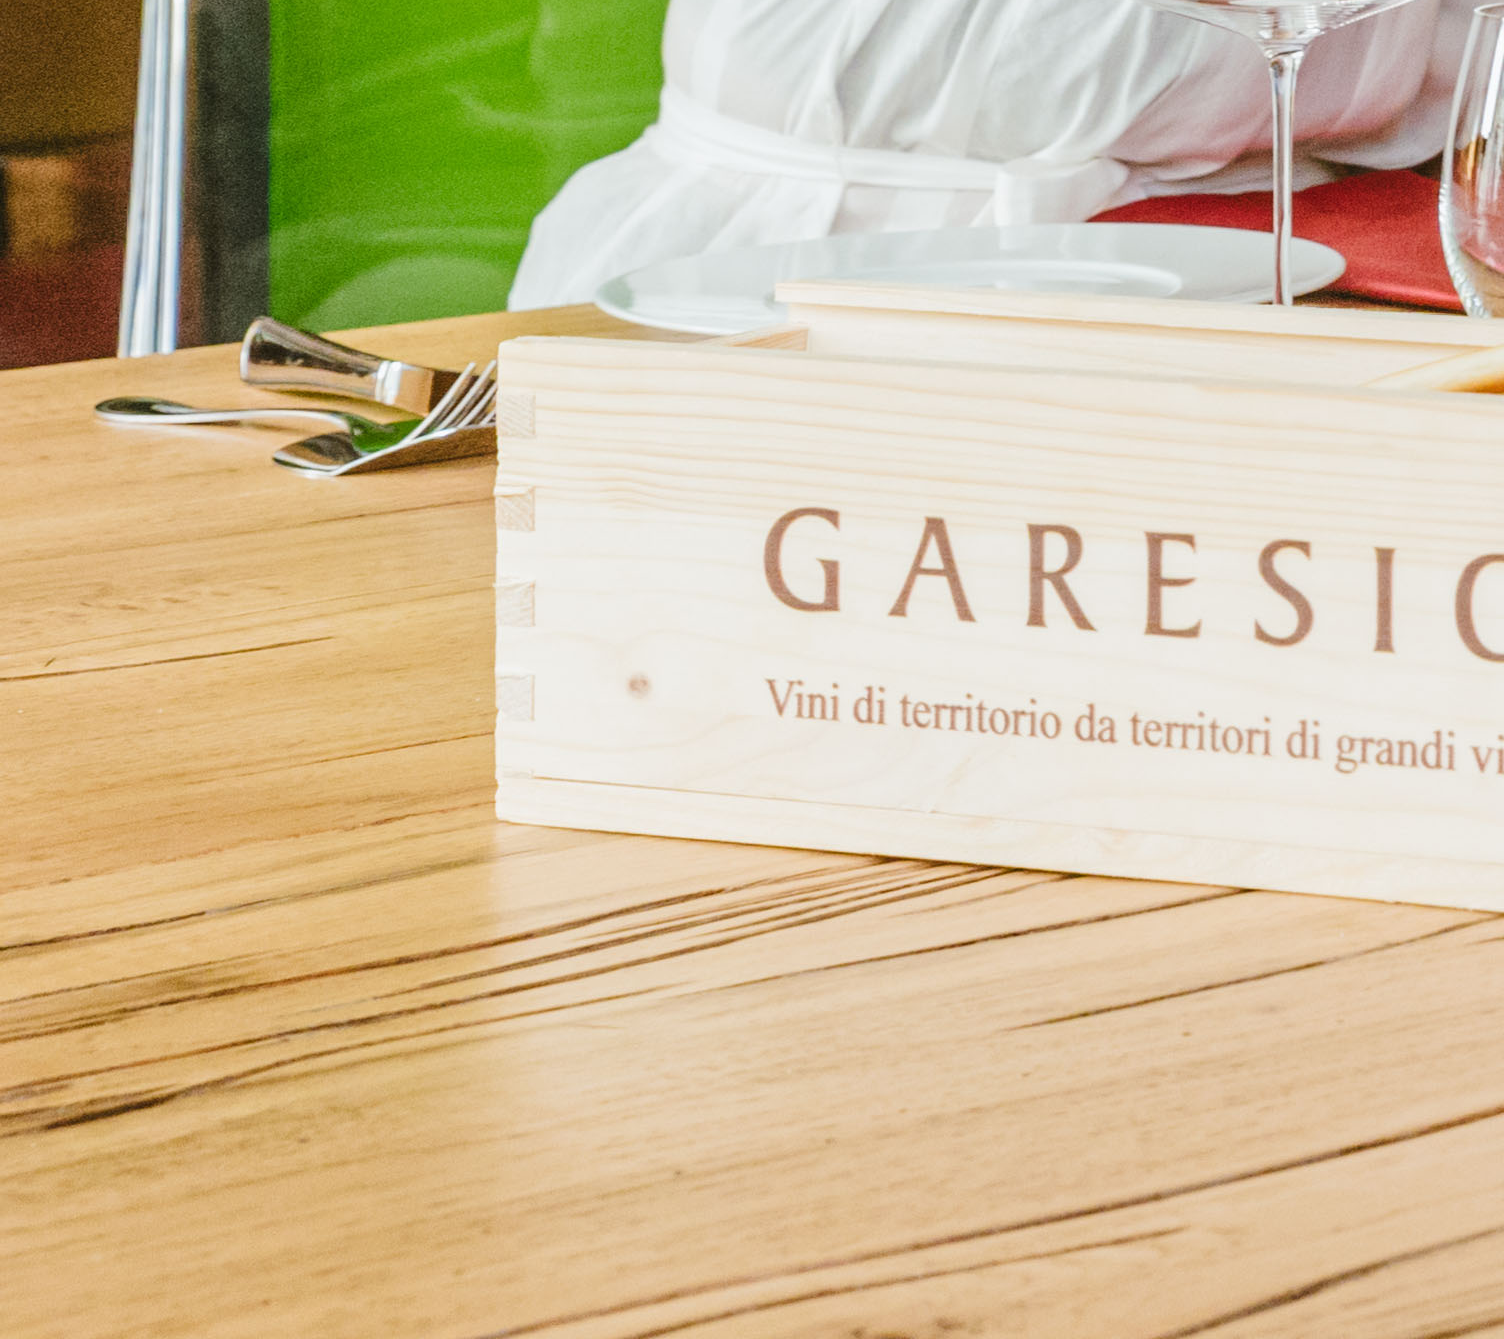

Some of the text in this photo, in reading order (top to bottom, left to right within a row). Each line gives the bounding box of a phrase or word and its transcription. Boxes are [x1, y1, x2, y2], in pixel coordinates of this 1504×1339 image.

[765, 678, 841, 723] Vini
[853, 686, 887, 726] di
[899, 691, 1059, 739] territorio
[1075, 703, 1117, 744] da
[1129, 711, 1272, 756] territori
[1286, 719, 1321, 761] di
[1334, 730, 1456, 774] grandi
